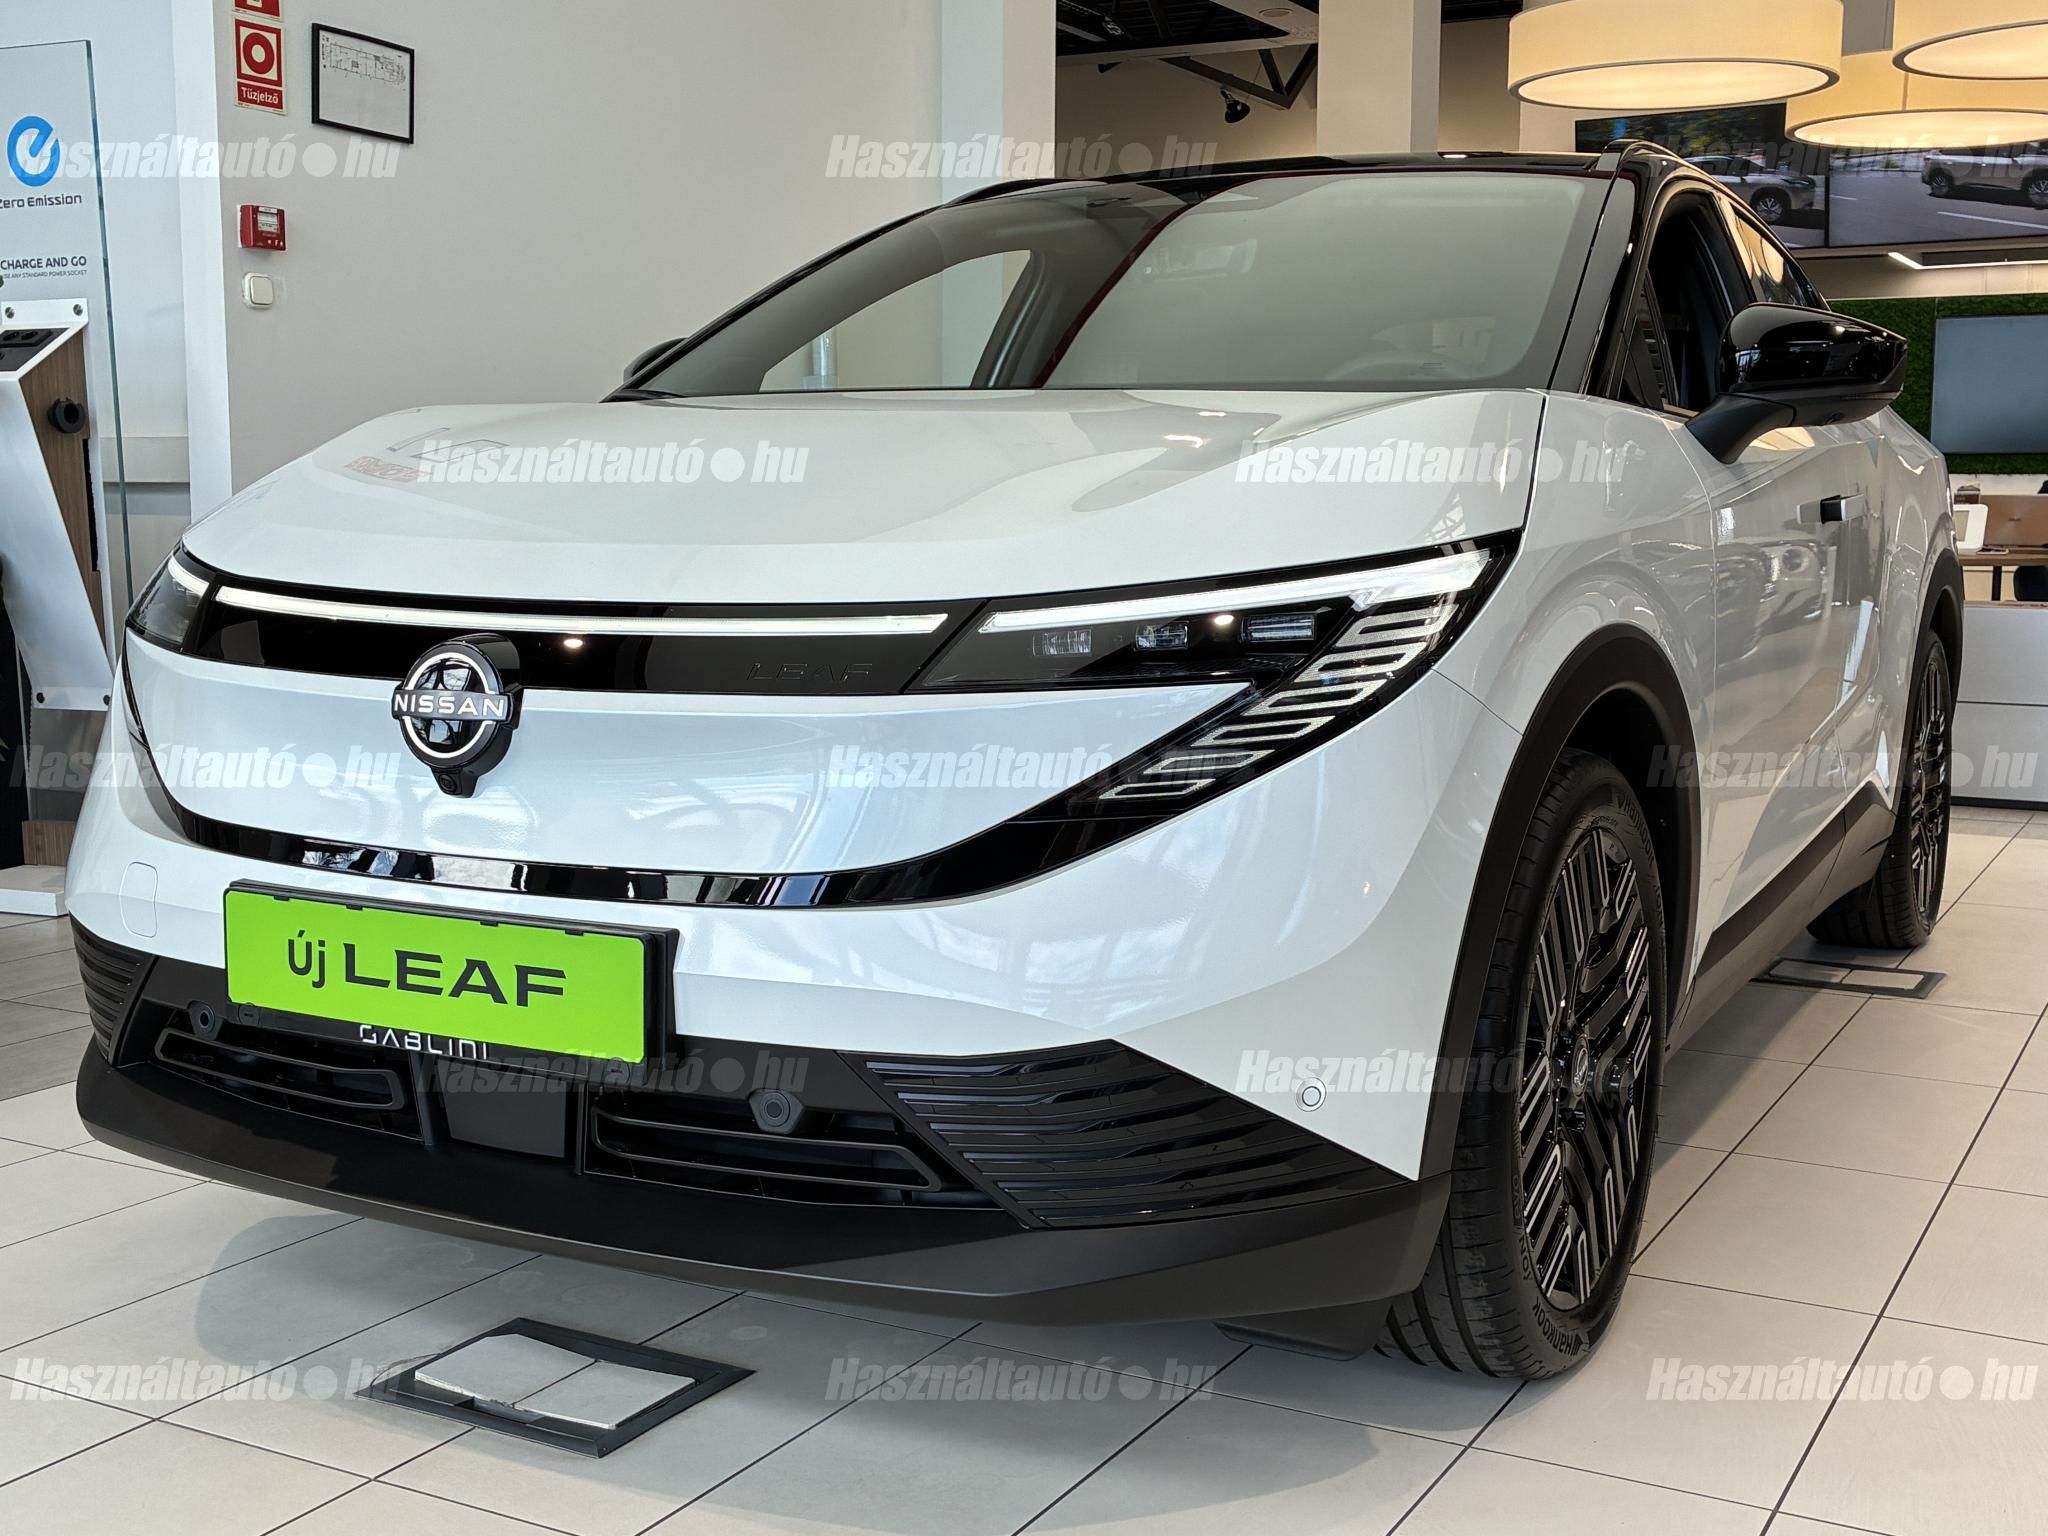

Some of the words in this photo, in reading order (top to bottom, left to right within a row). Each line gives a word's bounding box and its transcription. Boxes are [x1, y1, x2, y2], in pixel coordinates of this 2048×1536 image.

[241, 86, 279, 105] Tűzjelző
[27, 193, 82, 207] Emission
[0, 258, 43, 270] CHARGE
[45, 256, 69, 268] AND
[71, 255, 87, 267] GO
[22, 271, 49, 279] STANDARD
[394, 693, 504, 717] NISSAN
[287, 929, 327, 990] Új
[343, 942, 567, 1008] LEAF
[359, 1024, 488, 1061] GABLINI
